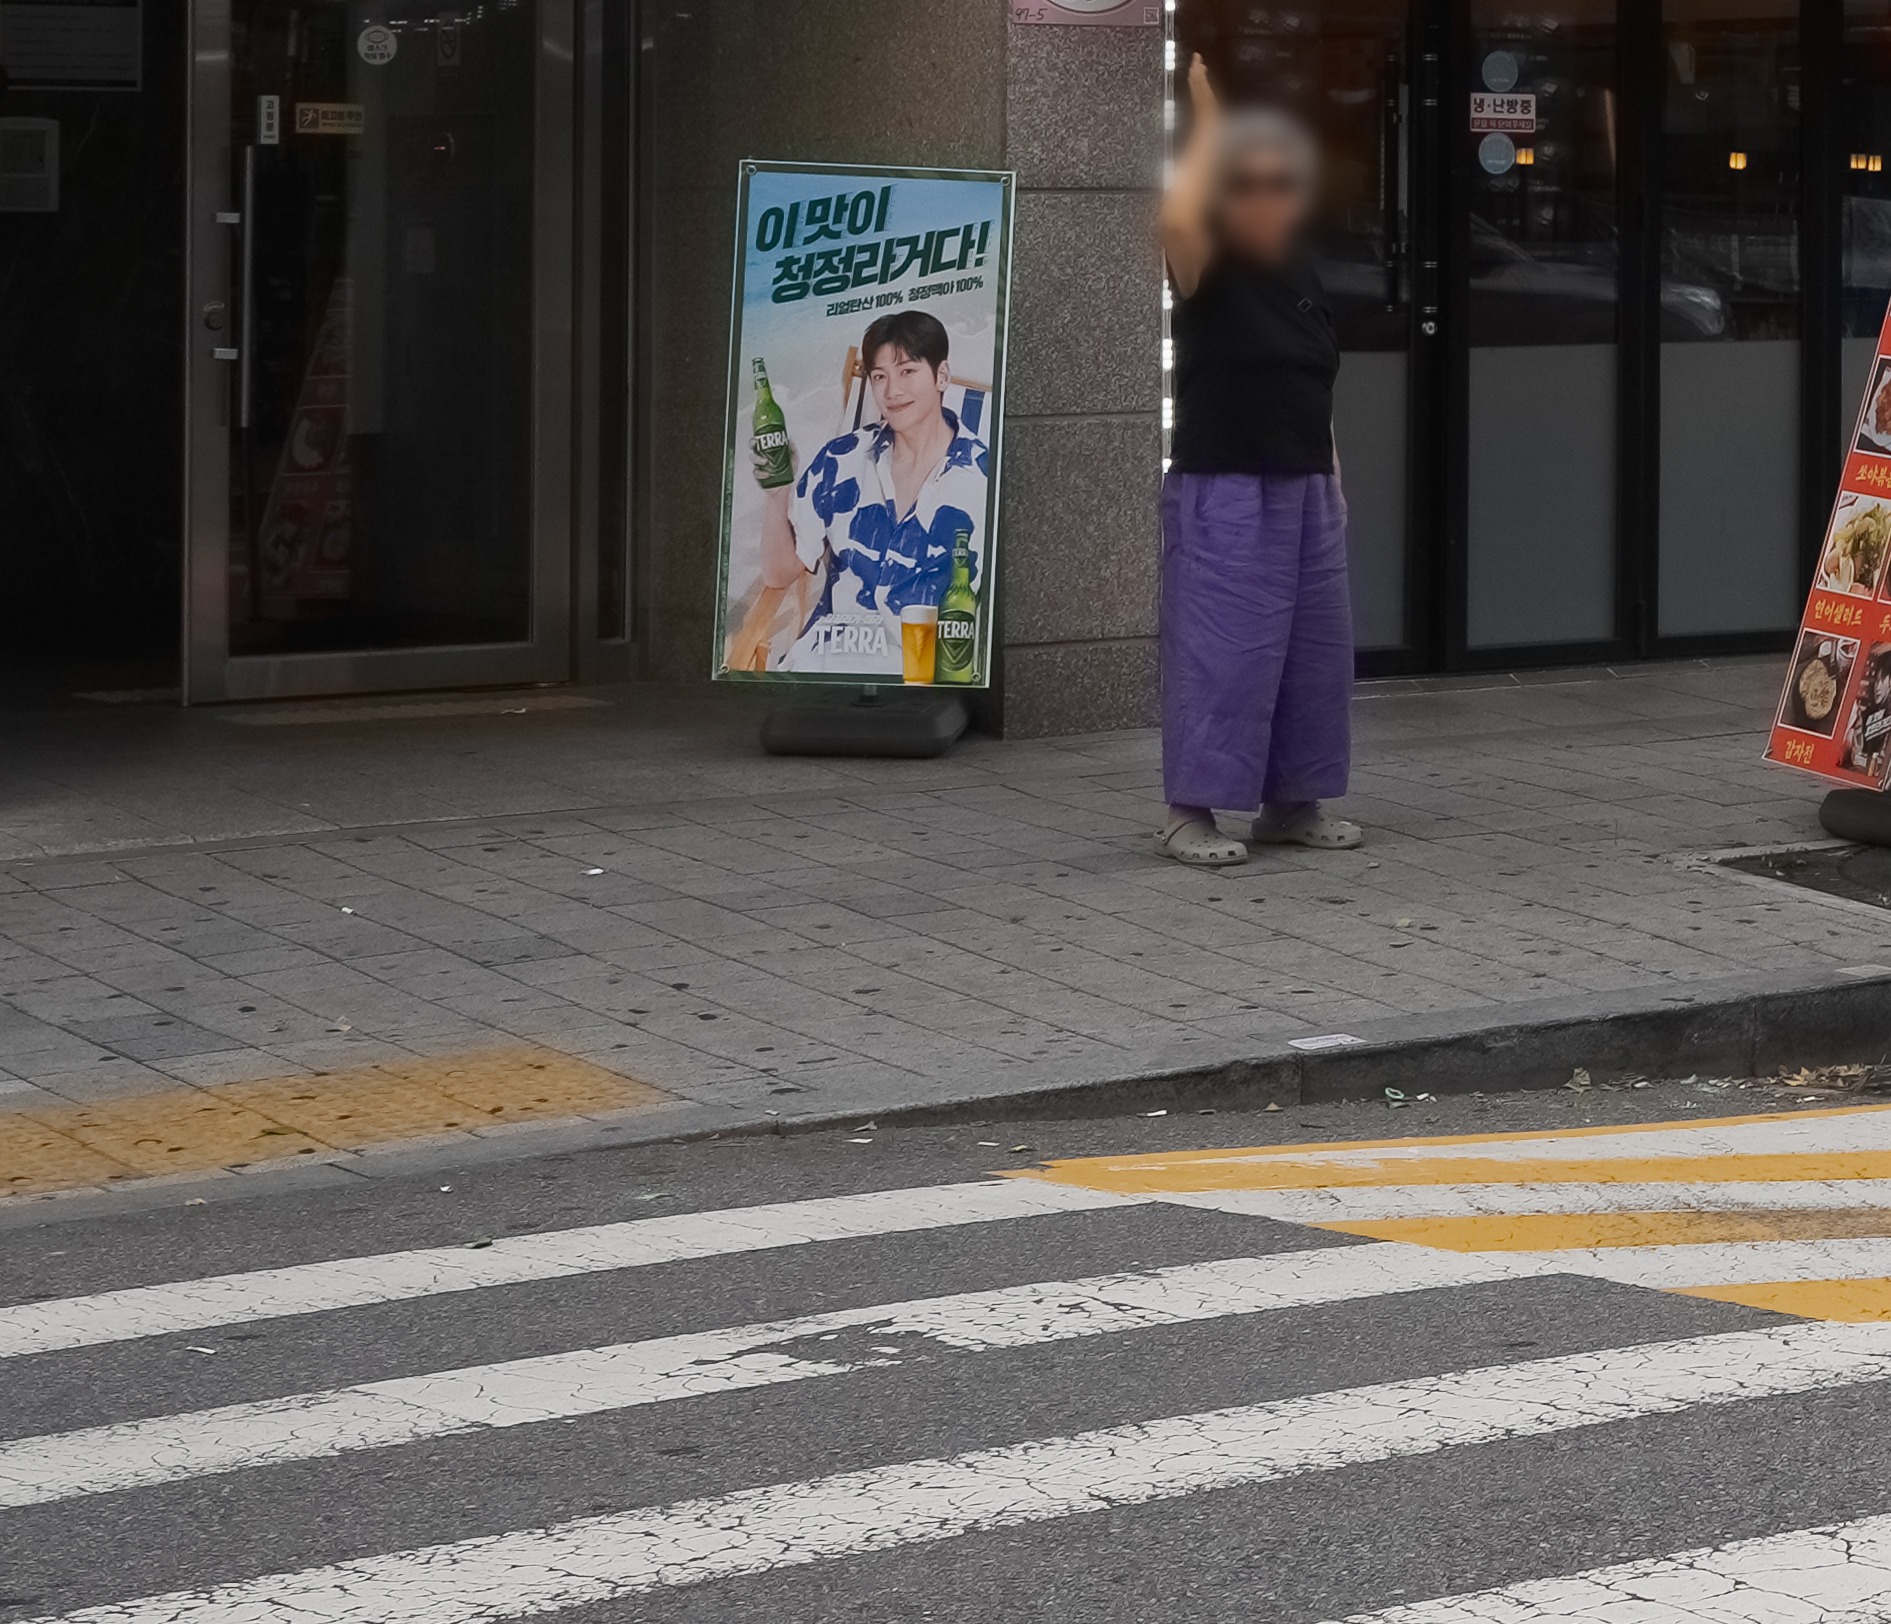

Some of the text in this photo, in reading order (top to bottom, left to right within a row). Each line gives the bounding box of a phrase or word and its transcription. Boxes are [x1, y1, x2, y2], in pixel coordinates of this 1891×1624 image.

[1015, 8, 1048, 21] 97-5
[772, 220, 991, 304] 청정라거다!
[826, 297, 873, 317] 리얼탄산
[875, 291, 903, 307] 100%
[956, 277, 983, 293] 100%
[754, 432, 788, 451] TERRA
[815, 626, 890, 657] TERRA
[937, 620, 974, 639] TERRA
